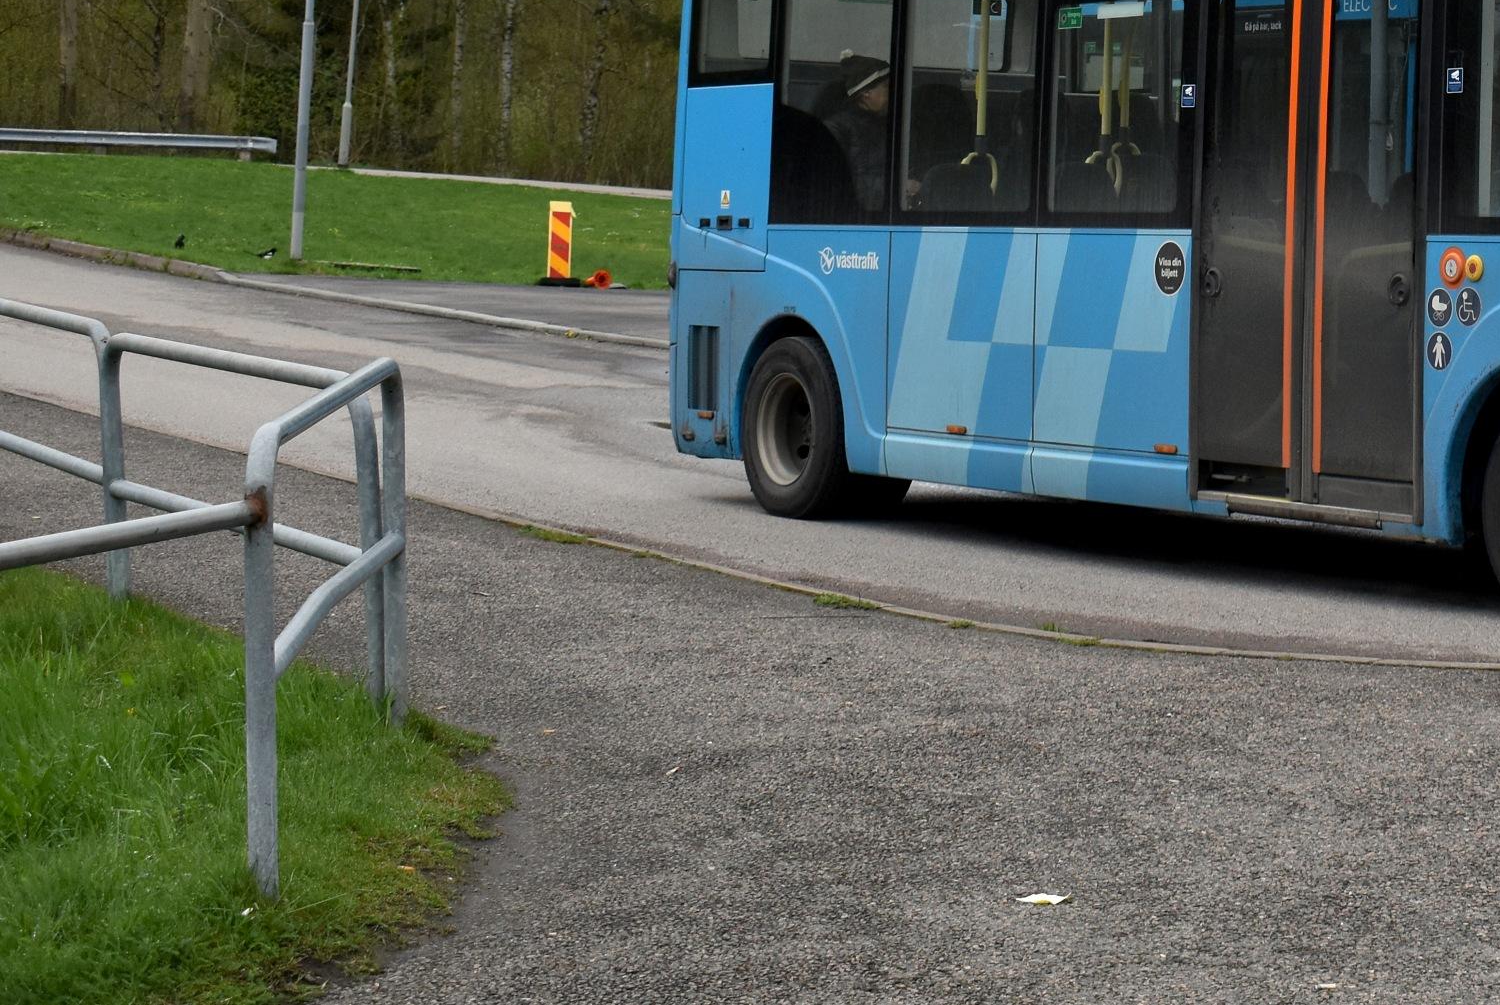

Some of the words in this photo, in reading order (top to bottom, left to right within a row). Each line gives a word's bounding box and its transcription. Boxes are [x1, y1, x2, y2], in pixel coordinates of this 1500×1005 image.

[836, 250, 879, 270] västtrafik
[1159, 257, 1171, 266] Visa
[1172, 257, 1182, 266] din
[1161, 268, 1178, 279] biljett
